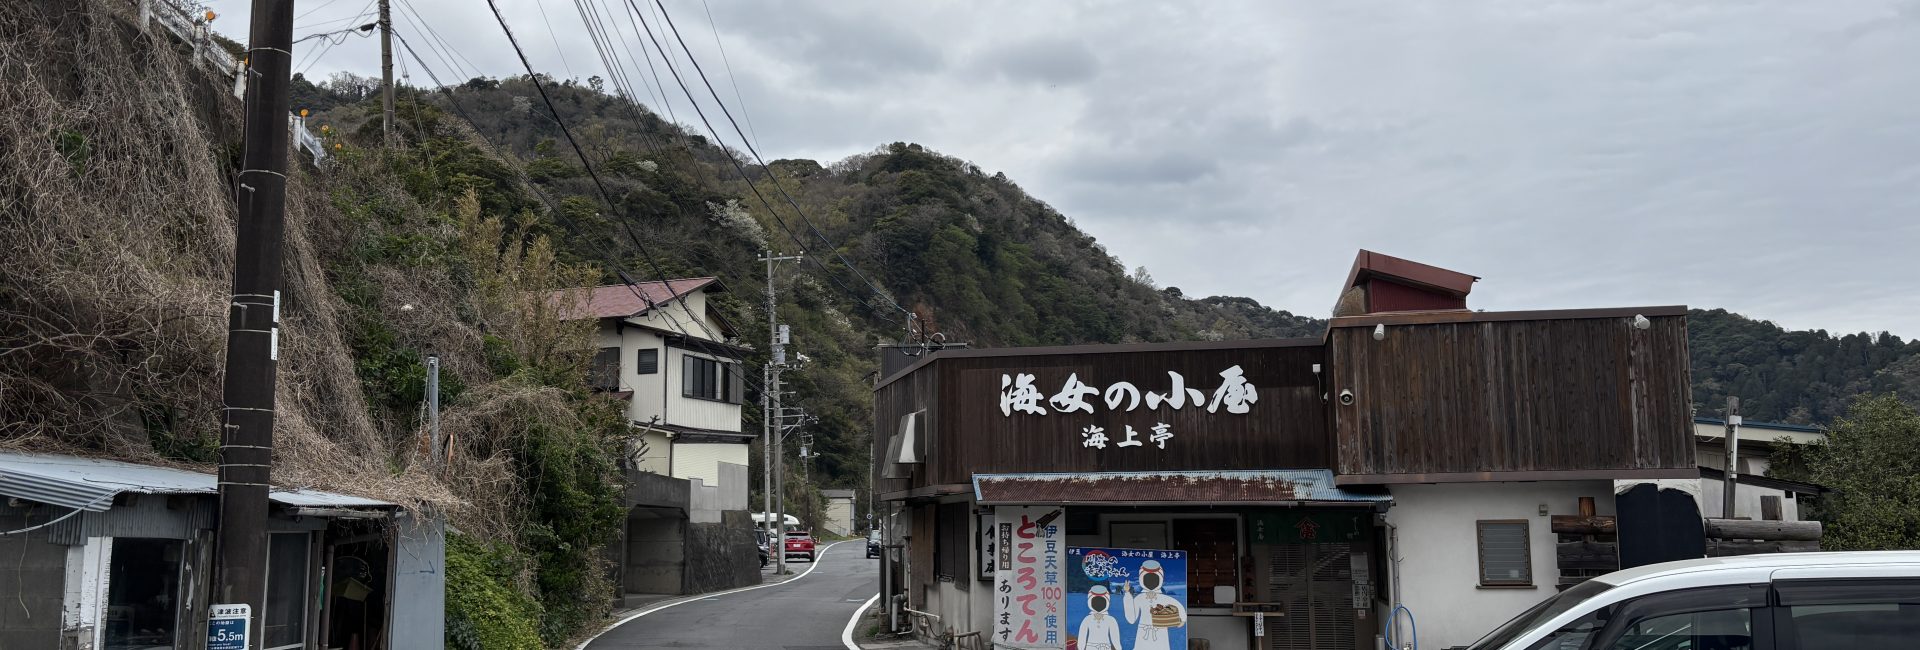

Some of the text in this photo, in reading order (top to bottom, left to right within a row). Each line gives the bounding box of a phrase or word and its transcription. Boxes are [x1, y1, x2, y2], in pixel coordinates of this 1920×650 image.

[999, 364, 1259, 417] 海女の小屋
[1081, 421, 1175, 450] 海上亭
[1000, 524, 1010, 569] お持ち帰り用
[1121, 550, 1154, 558] 海女の小屋
[1160, 551, 1181, 559] 海上亭
[1014, 514, 1039, 644] ところてん
[1041, 524, 1062, 644] 伊豆天草100%使用
[998, 578, 1012, 642] あります
